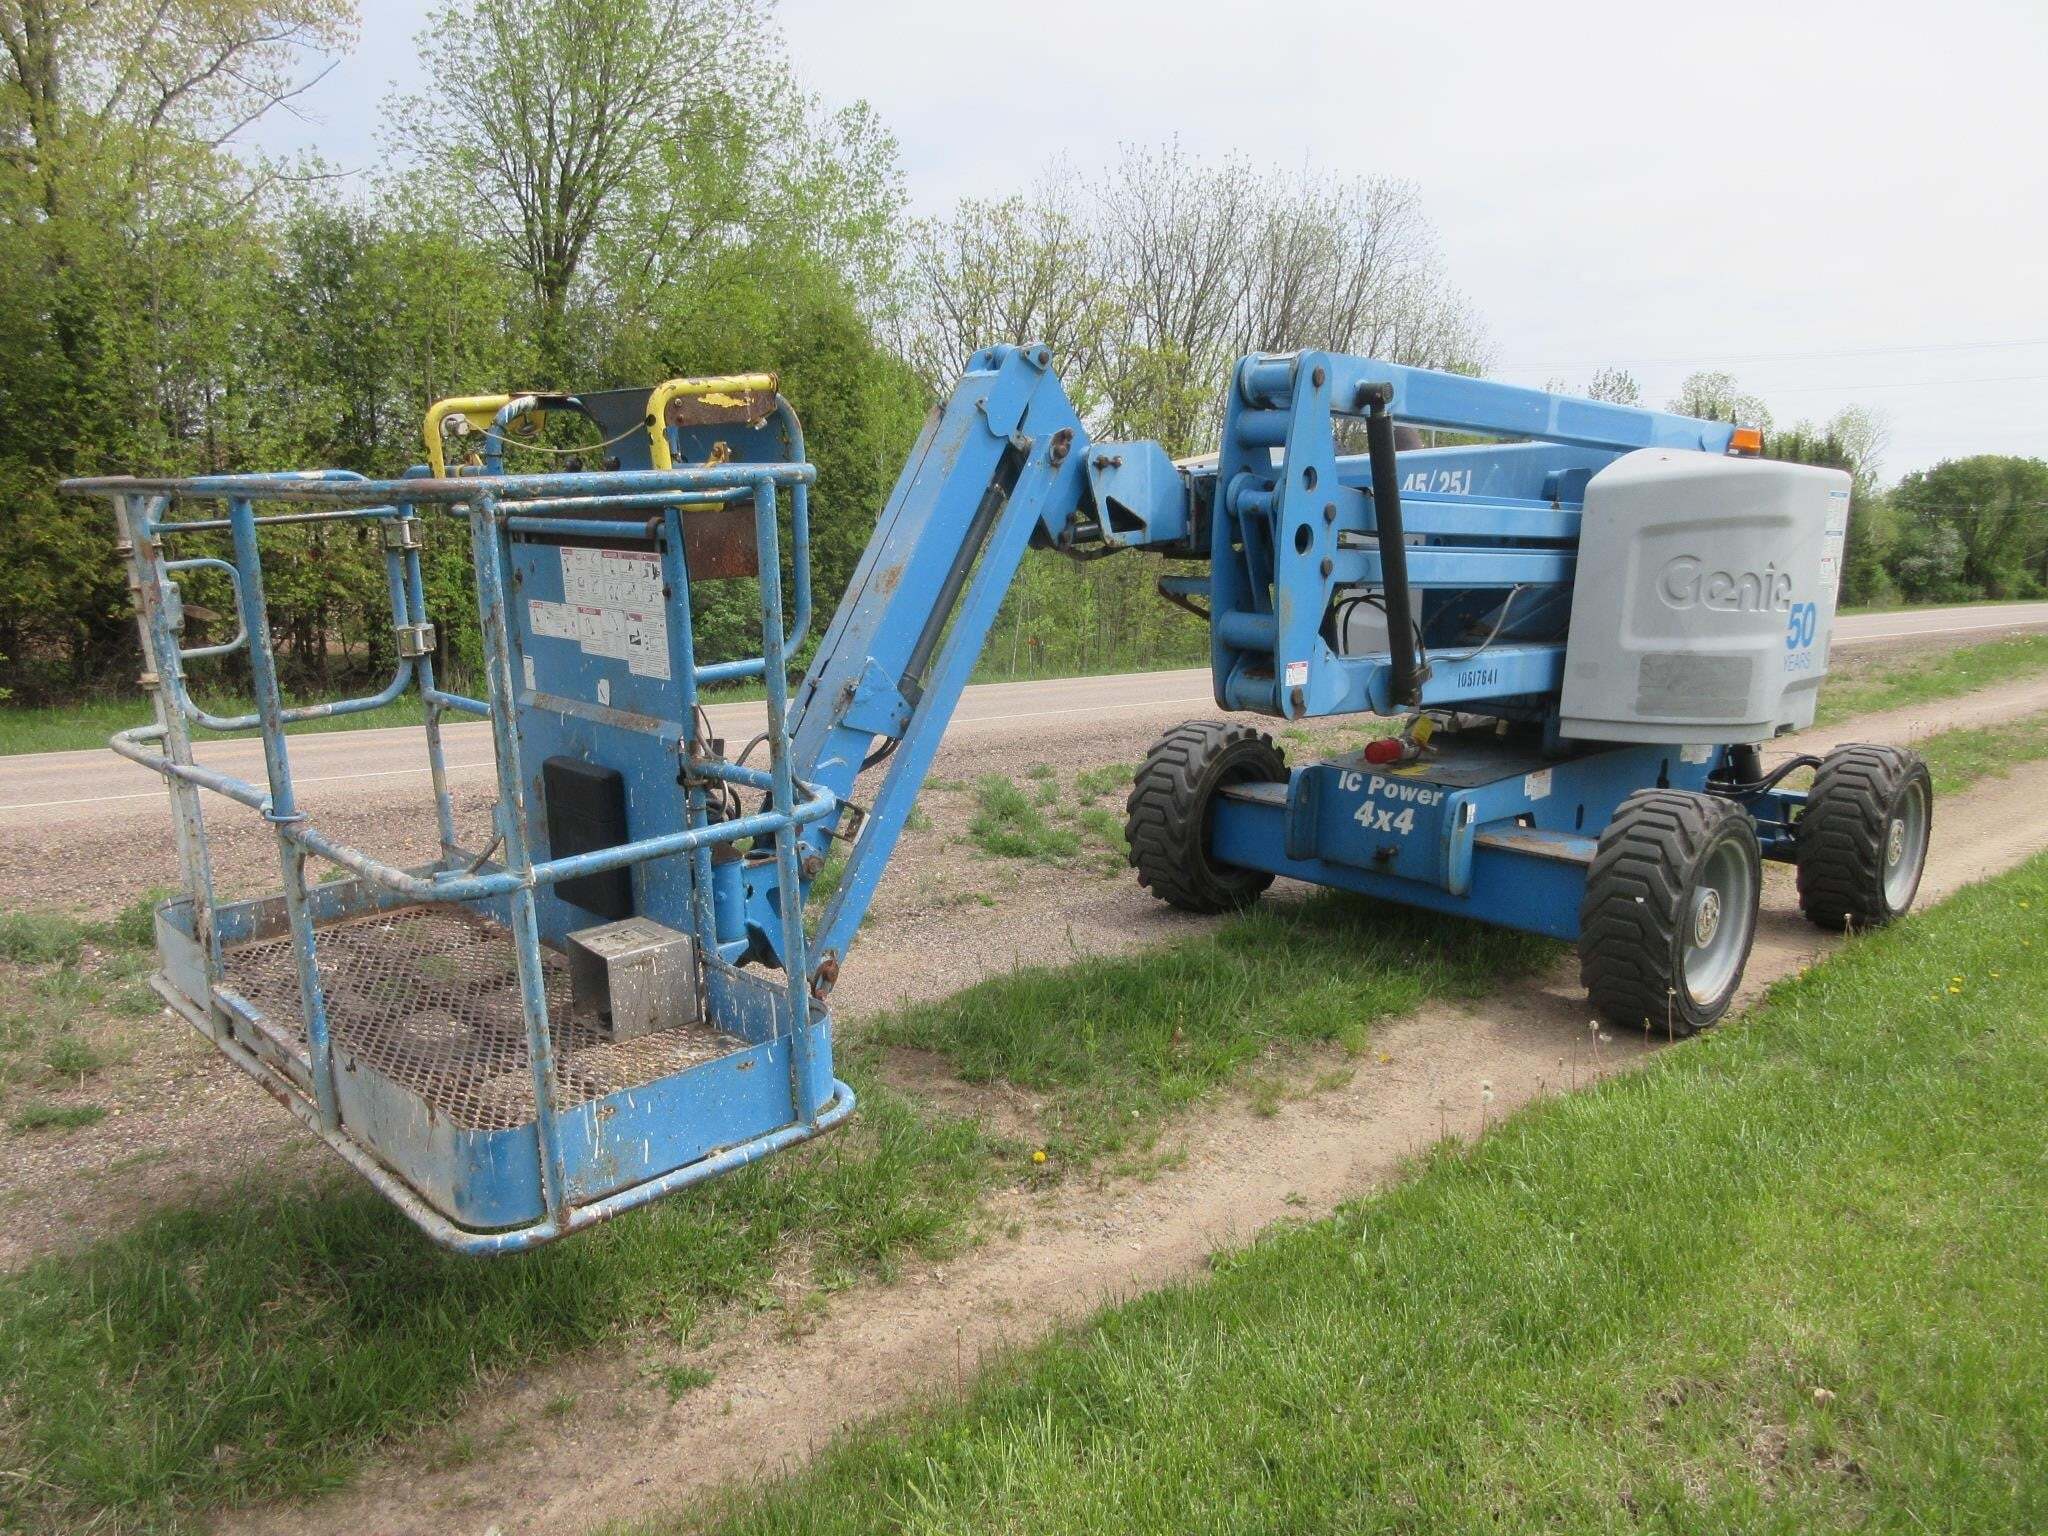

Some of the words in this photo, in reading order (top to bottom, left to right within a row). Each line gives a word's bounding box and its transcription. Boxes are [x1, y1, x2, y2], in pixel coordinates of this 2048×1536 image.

[1655, 554, 1793, 613] Genie
[1785, 602, 1817, 650] 50
[1783, 651, 1812, 673] YEARS
[1338, 770, 1362, 792] IC
[1368, 775, 1444, 807] Power
[1353, 800, 1415, 835] 4x4
